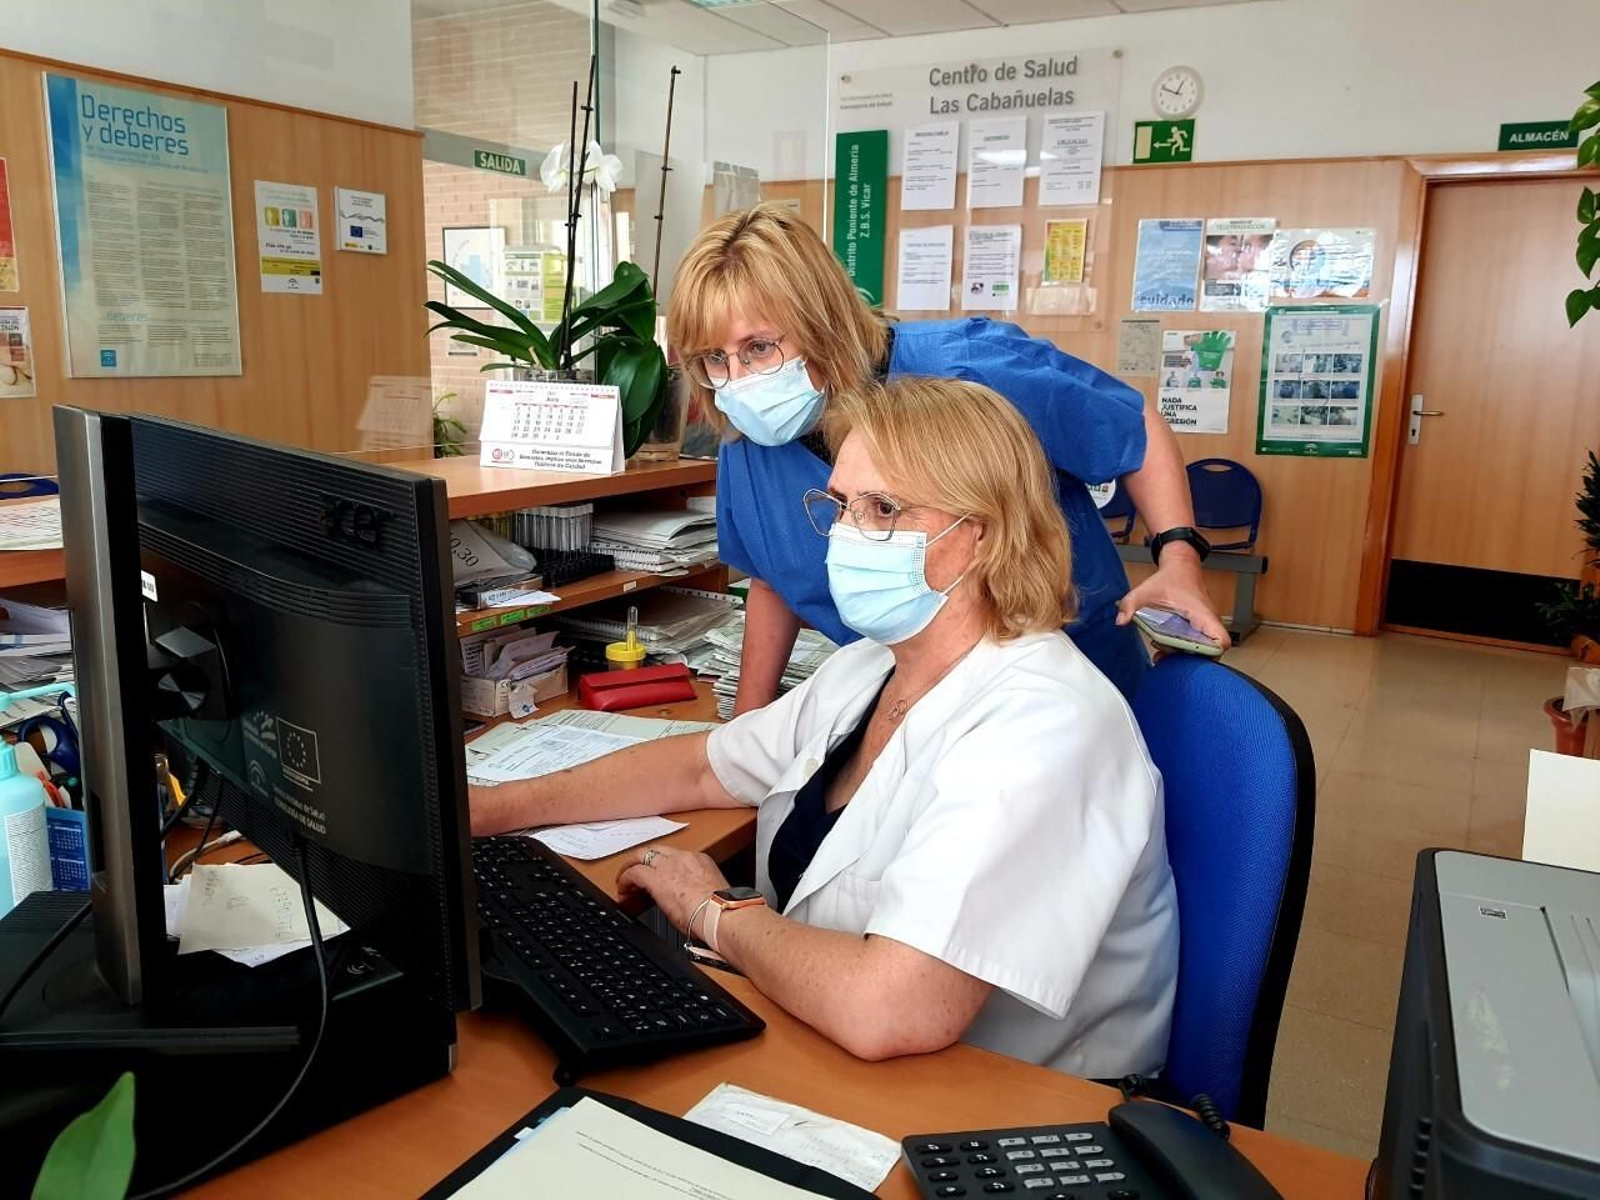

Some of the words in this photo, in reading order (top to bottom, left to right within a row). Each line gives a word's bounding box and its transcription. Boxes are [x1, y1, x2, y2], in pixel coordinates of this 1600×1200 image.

[929, 65, 988, 86] Centro
[995, 62, 1017, 81] de
[1024, 55, 1078, 79] Salud
[81, 94, 186, 134] Derechos
[930, 96, 960, 114] Las
[966, 87, 1075, 112] Cabañuelas
[82, 124, 93, 142] y
[100, 122, 189, 156] deberes
[1509, 130, 1569, 143] ALMACÉN
[480, 152, 521, 174] SALIDA
[860, 210, 870, 238] Z.B.S.
[1165, 417, 1197, 425] GRESIÓN
